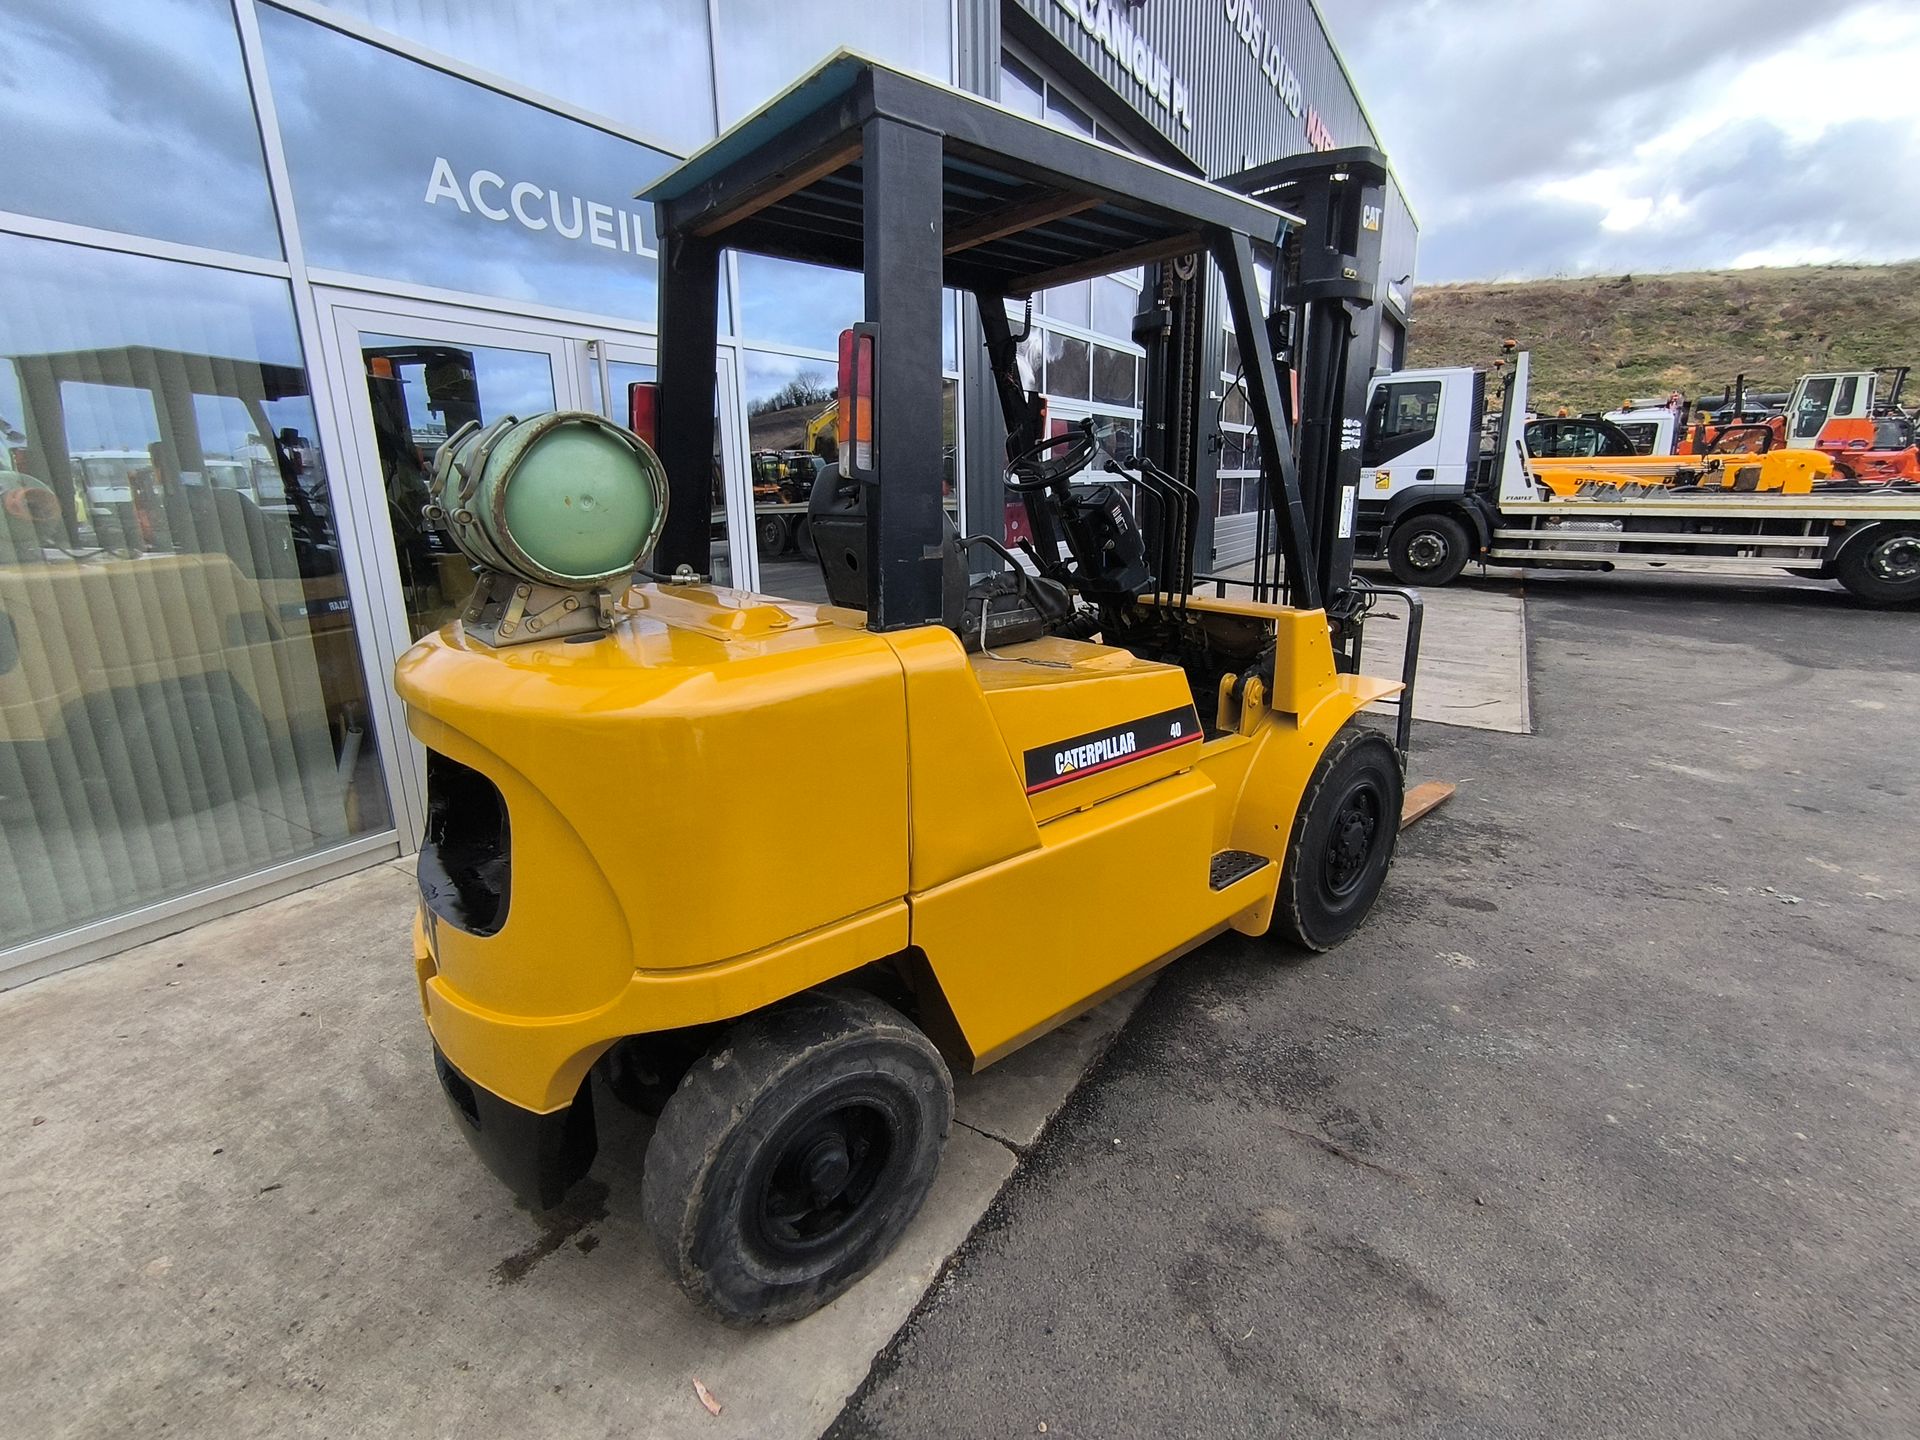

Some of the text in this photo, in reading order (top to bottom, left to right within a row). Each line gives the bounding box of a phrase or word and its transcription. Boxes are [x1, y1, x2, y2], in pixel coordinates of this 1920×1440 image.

[424, 156, 658, 259] ACCUEIL
[1362, 205, 1382, 231] CAT
[1170, 721, 1181, 738] 40
[1055, 731, 1135, 774] CATERPILLAR
